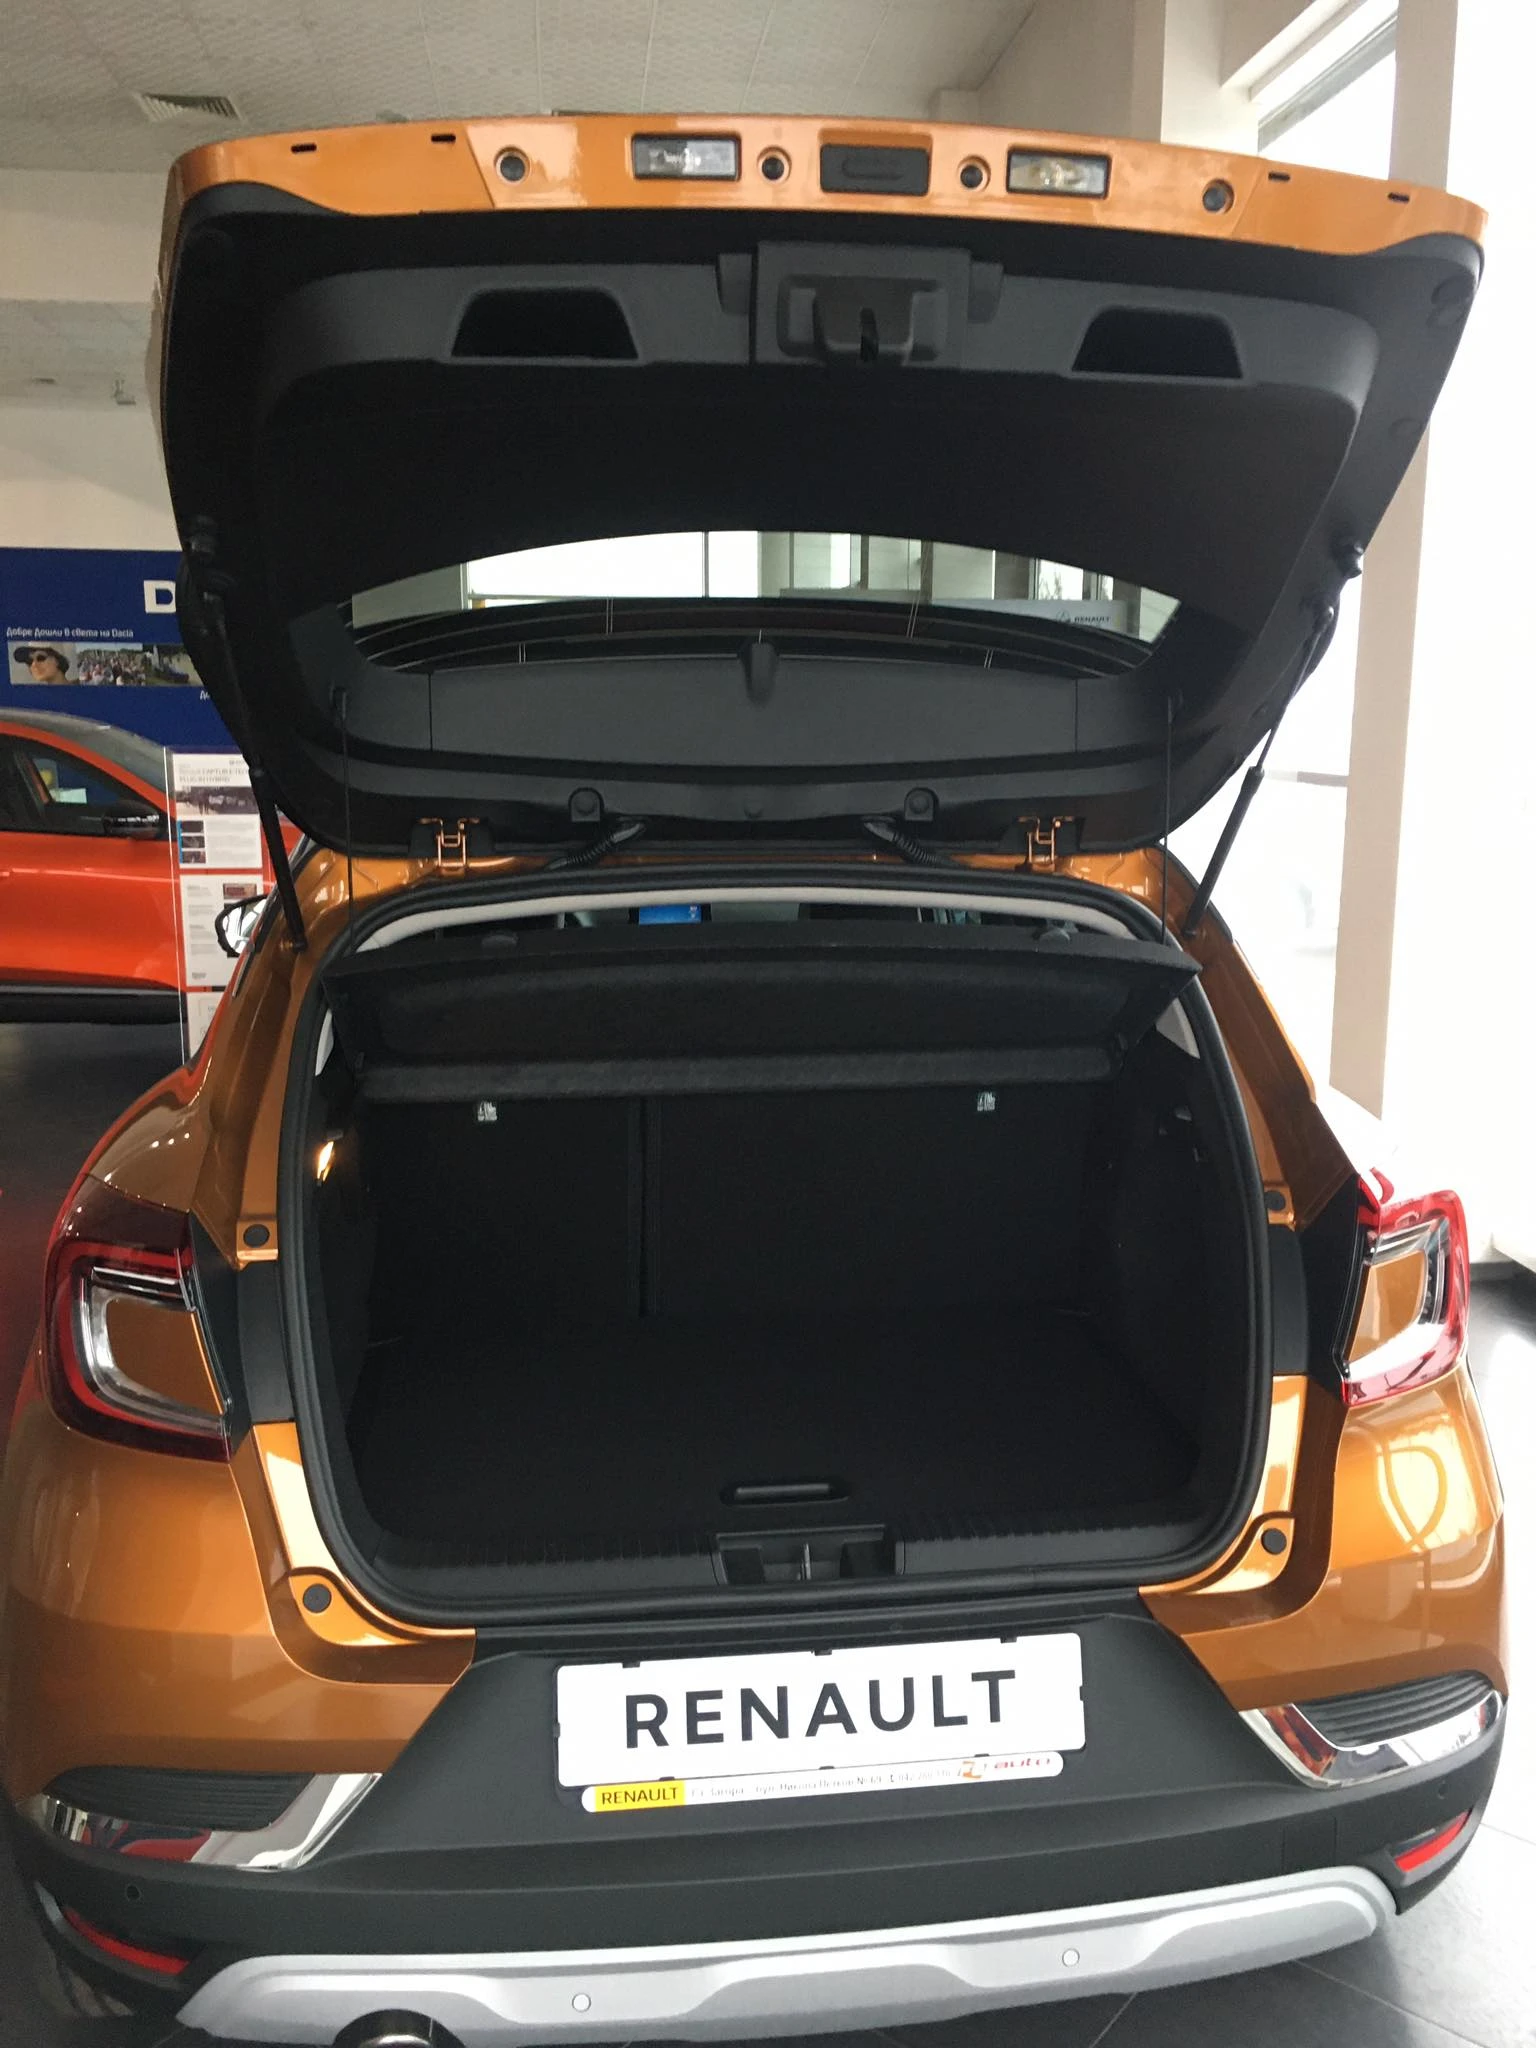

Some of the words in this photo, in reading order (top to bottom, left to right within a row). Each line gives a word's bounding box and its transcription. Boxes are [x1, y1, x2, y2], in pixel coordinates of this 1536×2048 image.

[6, 626, 32, 639] Добре
[100, 629, 110, 638] на
[111, 629, 134, 638] Dacia
[624, 1668, 1016, 1749] RENAULT
[601, 1787, 678, 1805] RENAULT
